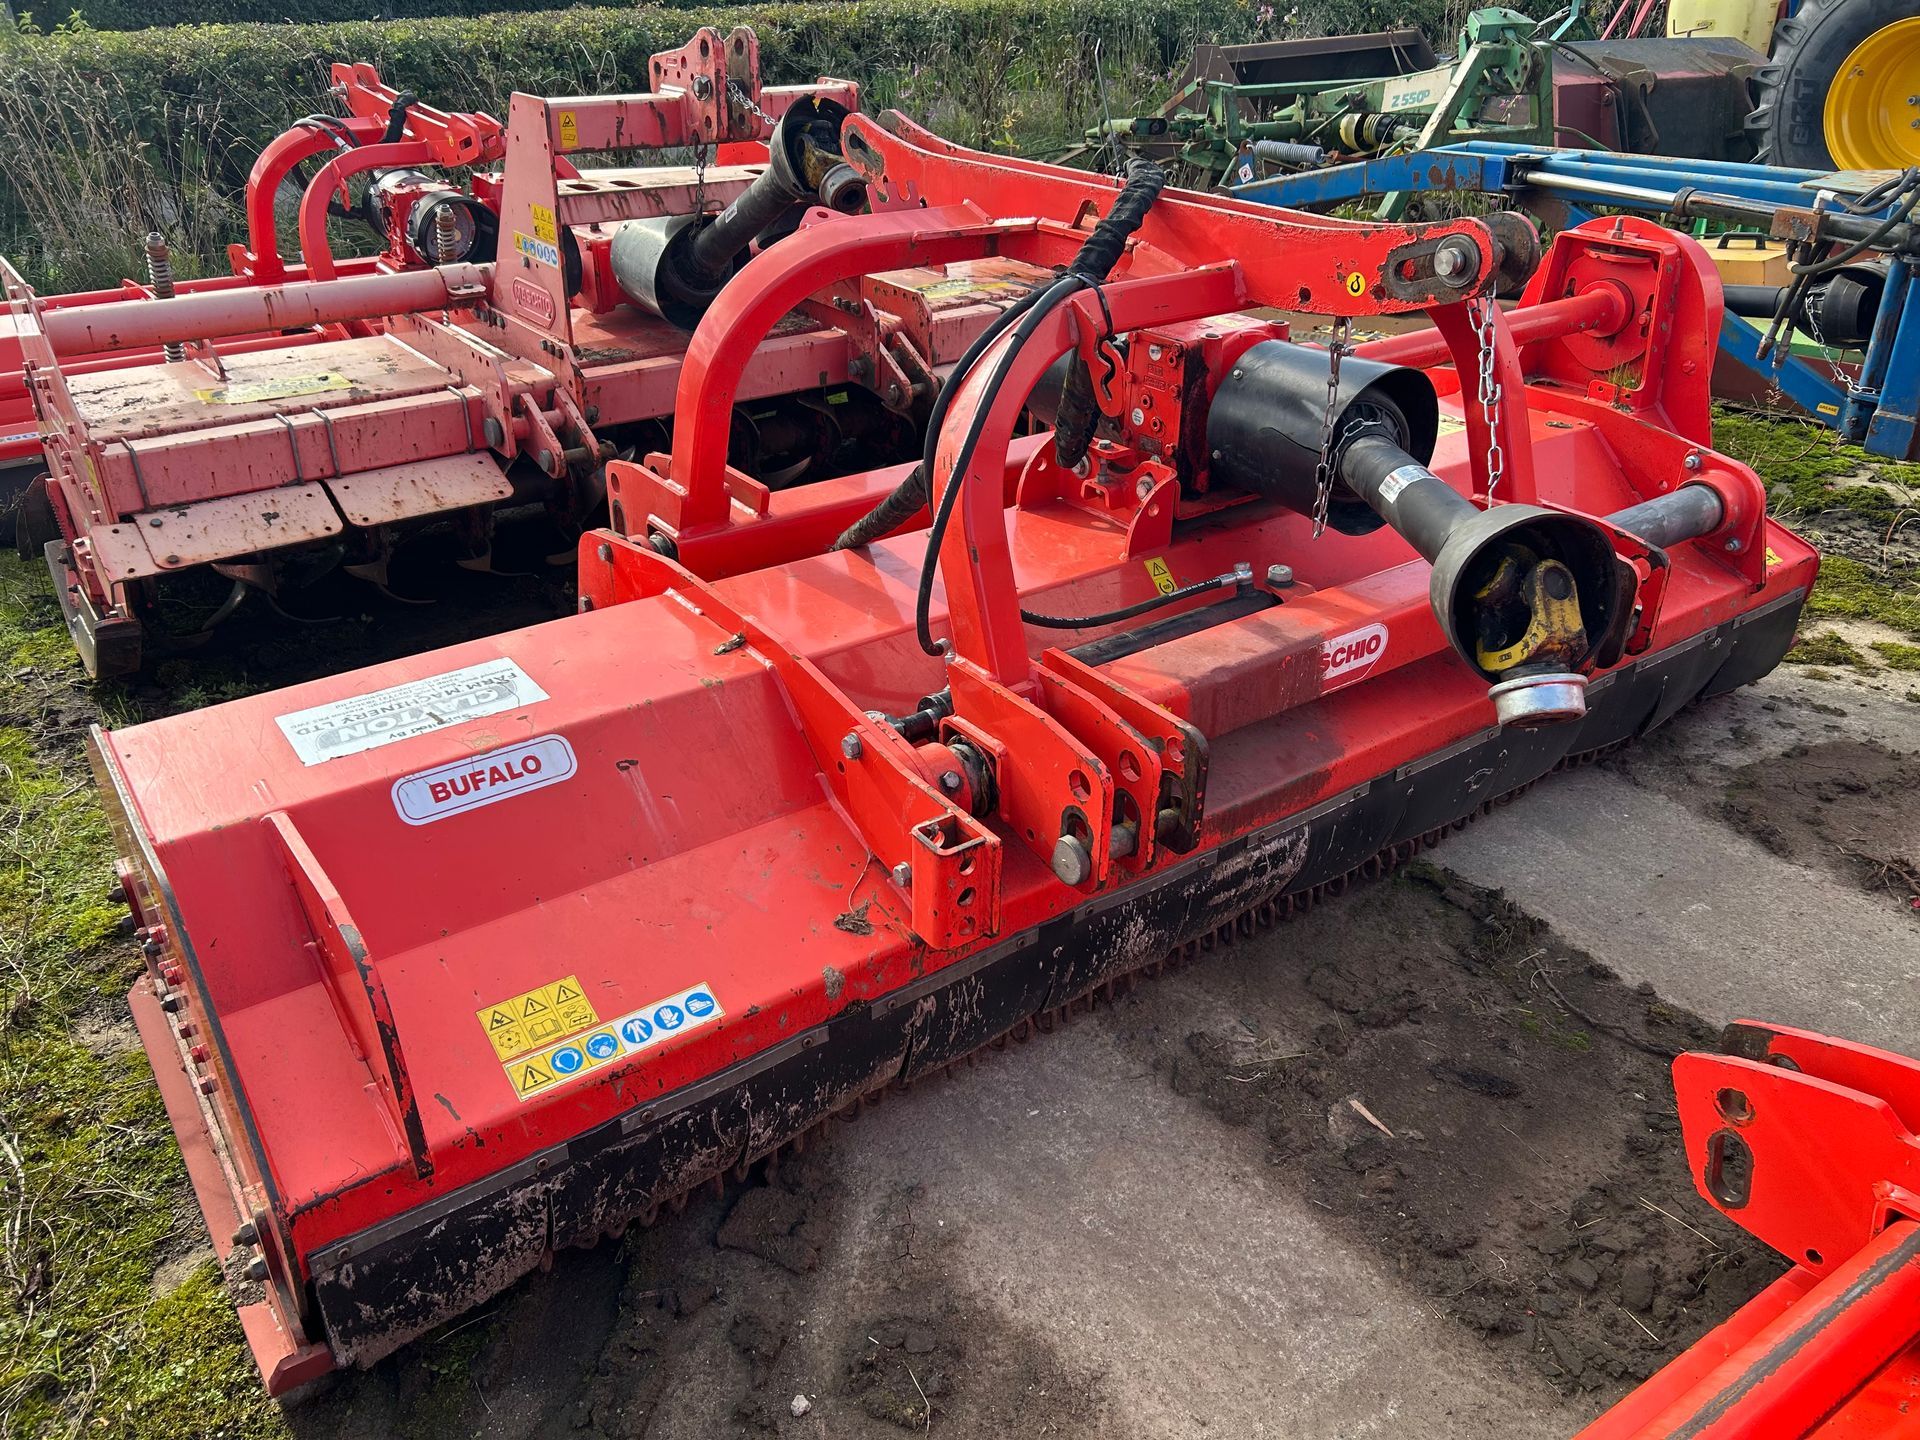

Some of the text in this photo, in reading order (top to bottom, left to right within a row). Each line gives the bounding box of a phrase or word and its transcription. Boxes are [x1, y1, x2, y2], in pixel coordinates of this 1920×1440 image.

[1391, 95, 1400, 108] Z
[464, 672, 518, 690] FARM
[340, 688, 461, 723] MACHINERY
[295, 721, 335, 736] LTD
[386, 730, 407, 739] By
[429, 754, 542, 804] BUFALO
